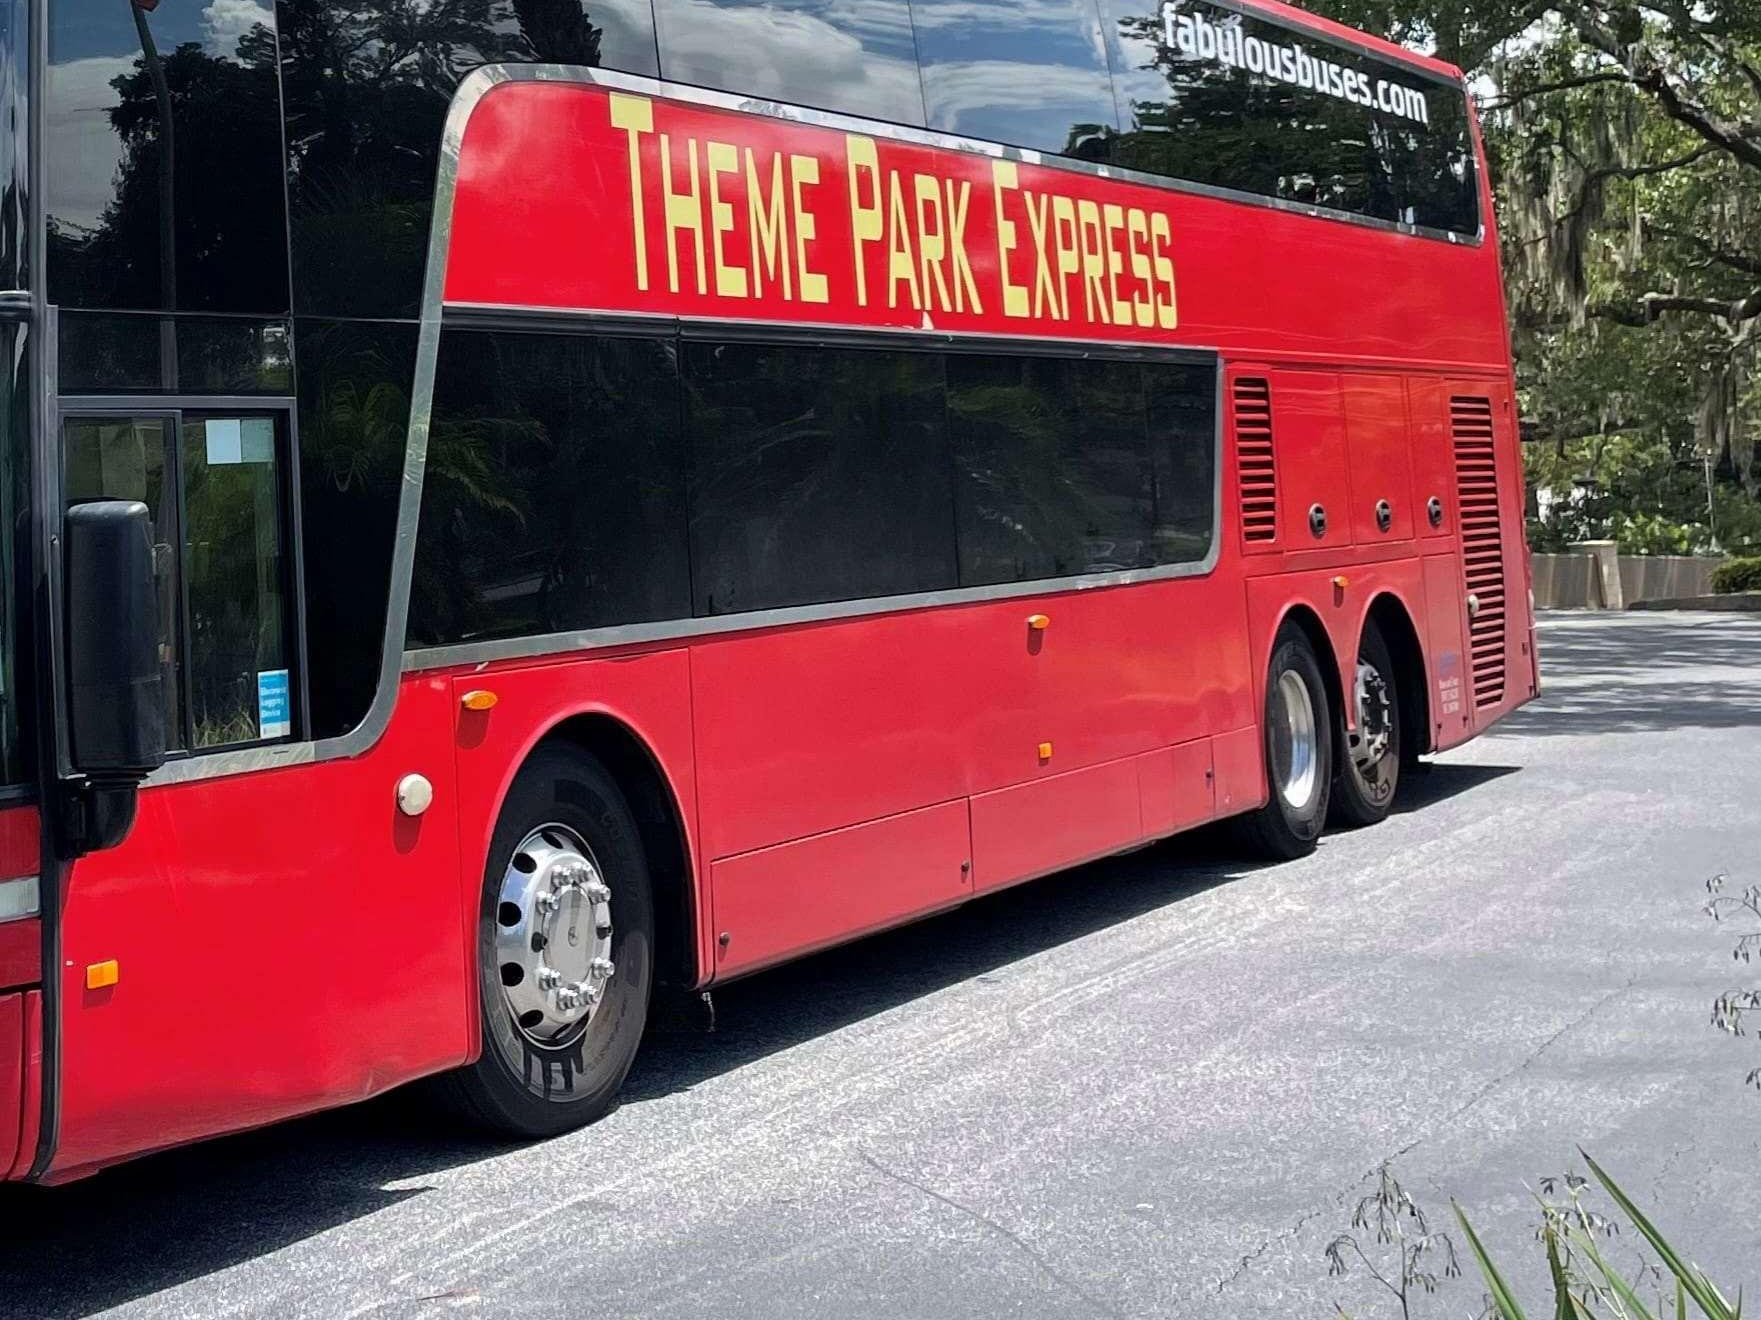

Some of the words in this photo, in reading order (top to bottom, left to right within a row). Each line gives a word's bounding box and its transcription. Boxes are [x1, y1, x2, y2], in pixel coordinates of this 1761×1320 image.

[1162, 1, 1429, 124] fabulousbuses.com
[609, 91, 829, 304] THEME
[846, 134, 983, 315] PARK
[992, 160, 1178, 330] EXPRESS
